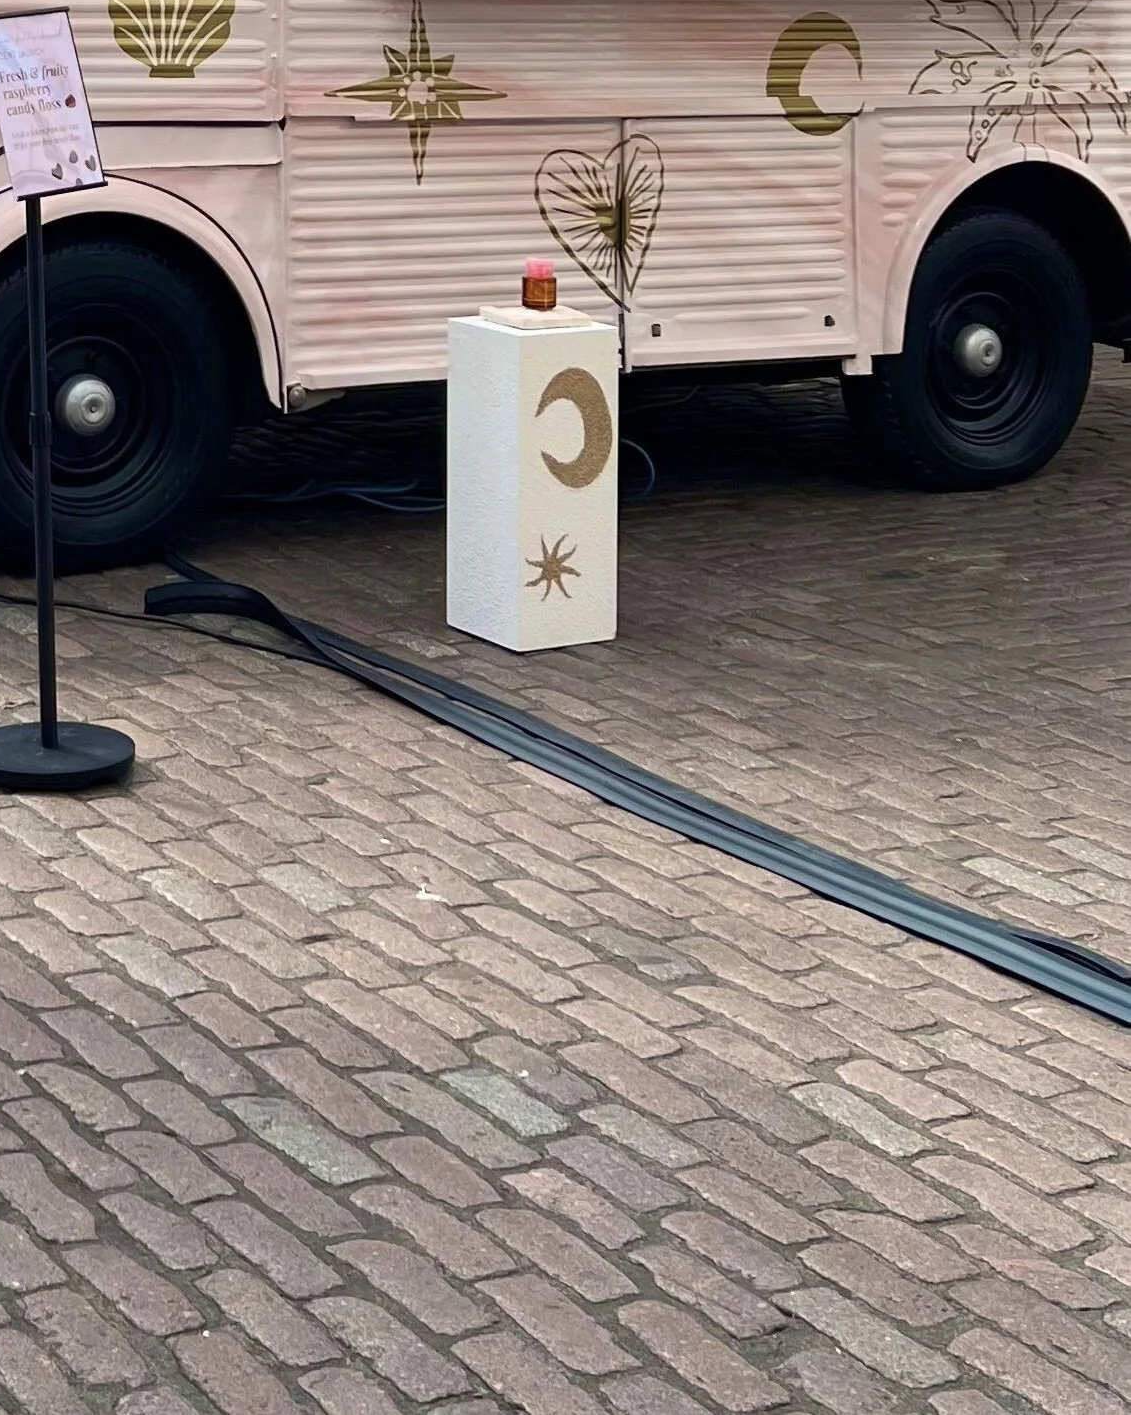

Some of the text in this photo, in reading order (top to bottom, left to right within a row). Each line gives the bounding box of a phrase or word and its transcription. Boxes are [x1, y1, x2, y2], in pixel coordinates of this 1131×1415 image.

[41, 63, 69, 81] fruity
[3, 84, 51, 101] raspberry
[6, 97, 62, 117] candy floss
